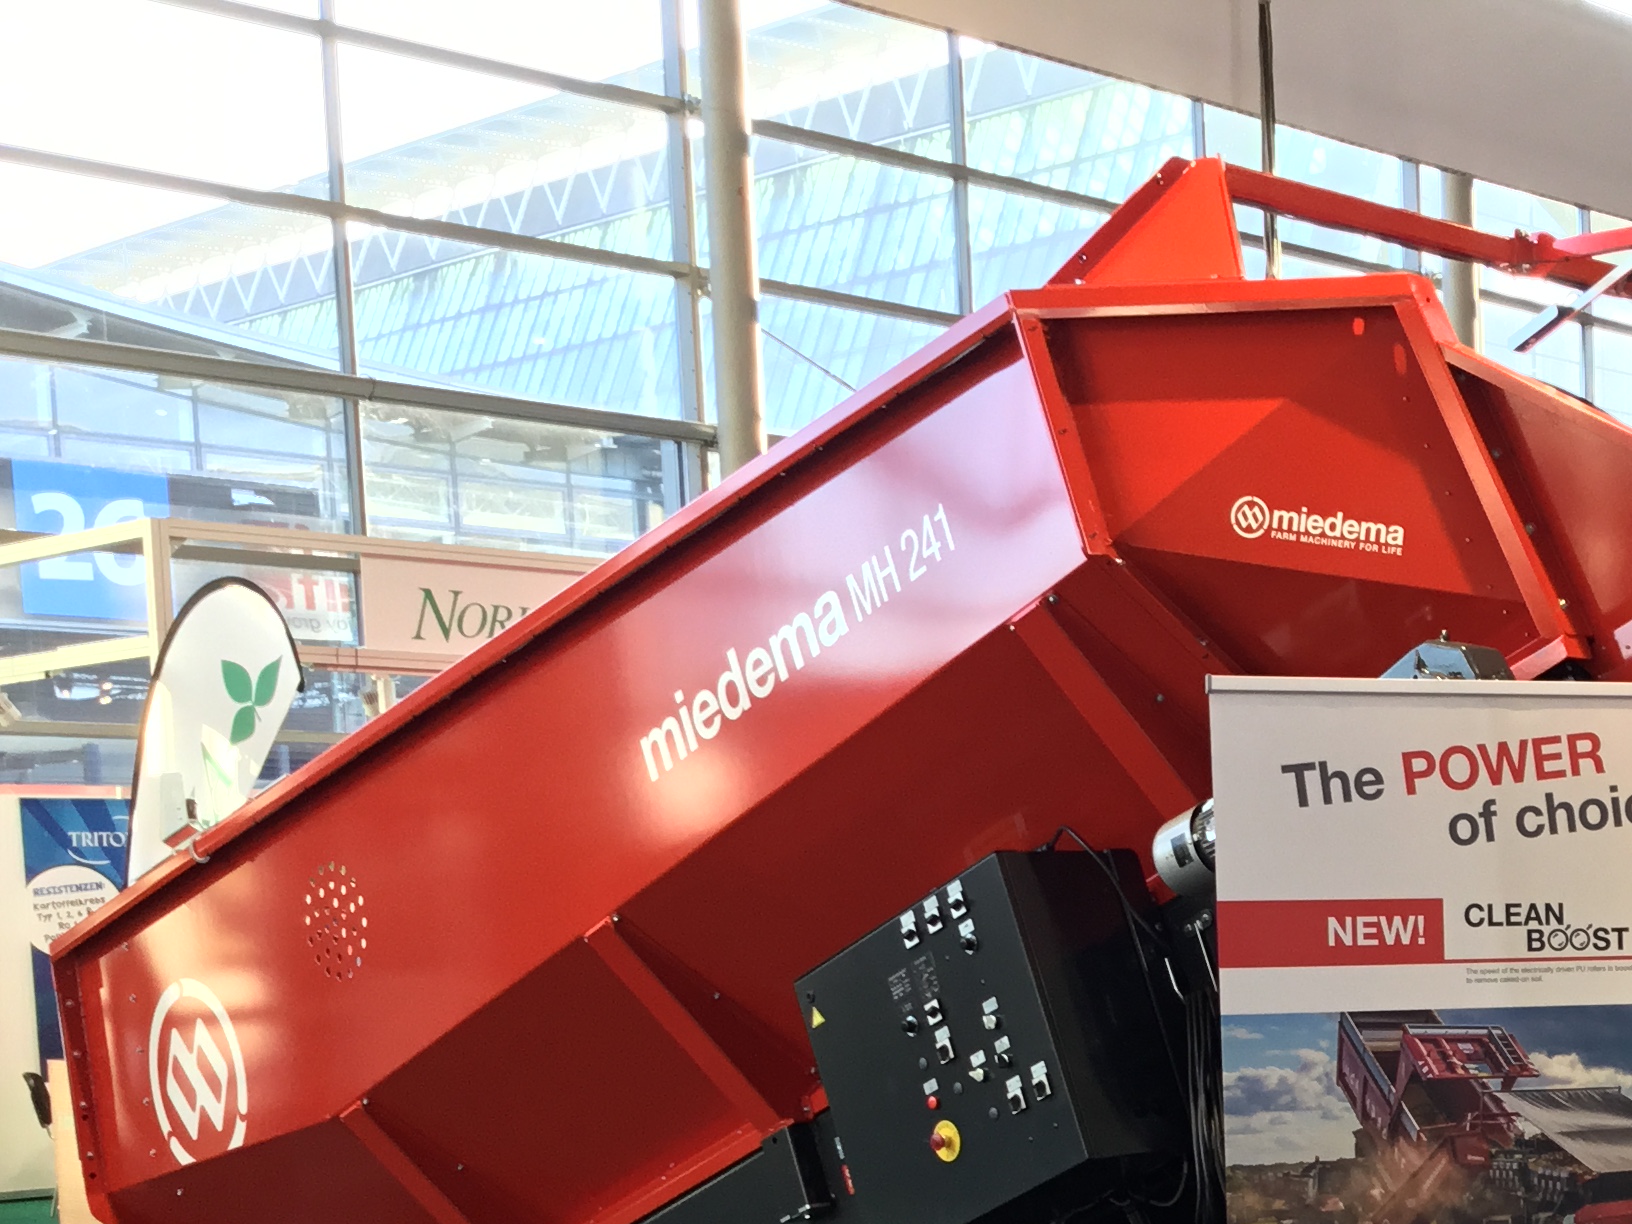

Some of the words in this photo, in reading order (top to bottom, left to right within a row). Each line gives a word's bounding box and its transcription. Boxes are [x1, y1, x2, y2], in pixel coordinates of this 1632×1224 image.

[1272, 507, 1405, 546] miedema
[1271, 530, 1297, 542] FARM
[1299, 534, 1356, 550] MACHINERY
[1359, 542, 1379, 553] FOR
[1382, 545, 1404, 556] LIFE
[640, 590, 849, 783] miedema
[845, 545, 902, 623] MH
[900, 502, 956, 582] 241
[1281, 760, 1385, 808] The
[1401, 732, 1605, 796] POWER
[1448, 799, 1498, 846] of
[67, 831, 128, 848] TRITO
[1464, 902, 1565, 927] CLEAN
[1328, 915, 1425, 947] NEW!
[1527, 924, 1630, 952] BOOST
[1466, 967, 1478, 975] The
